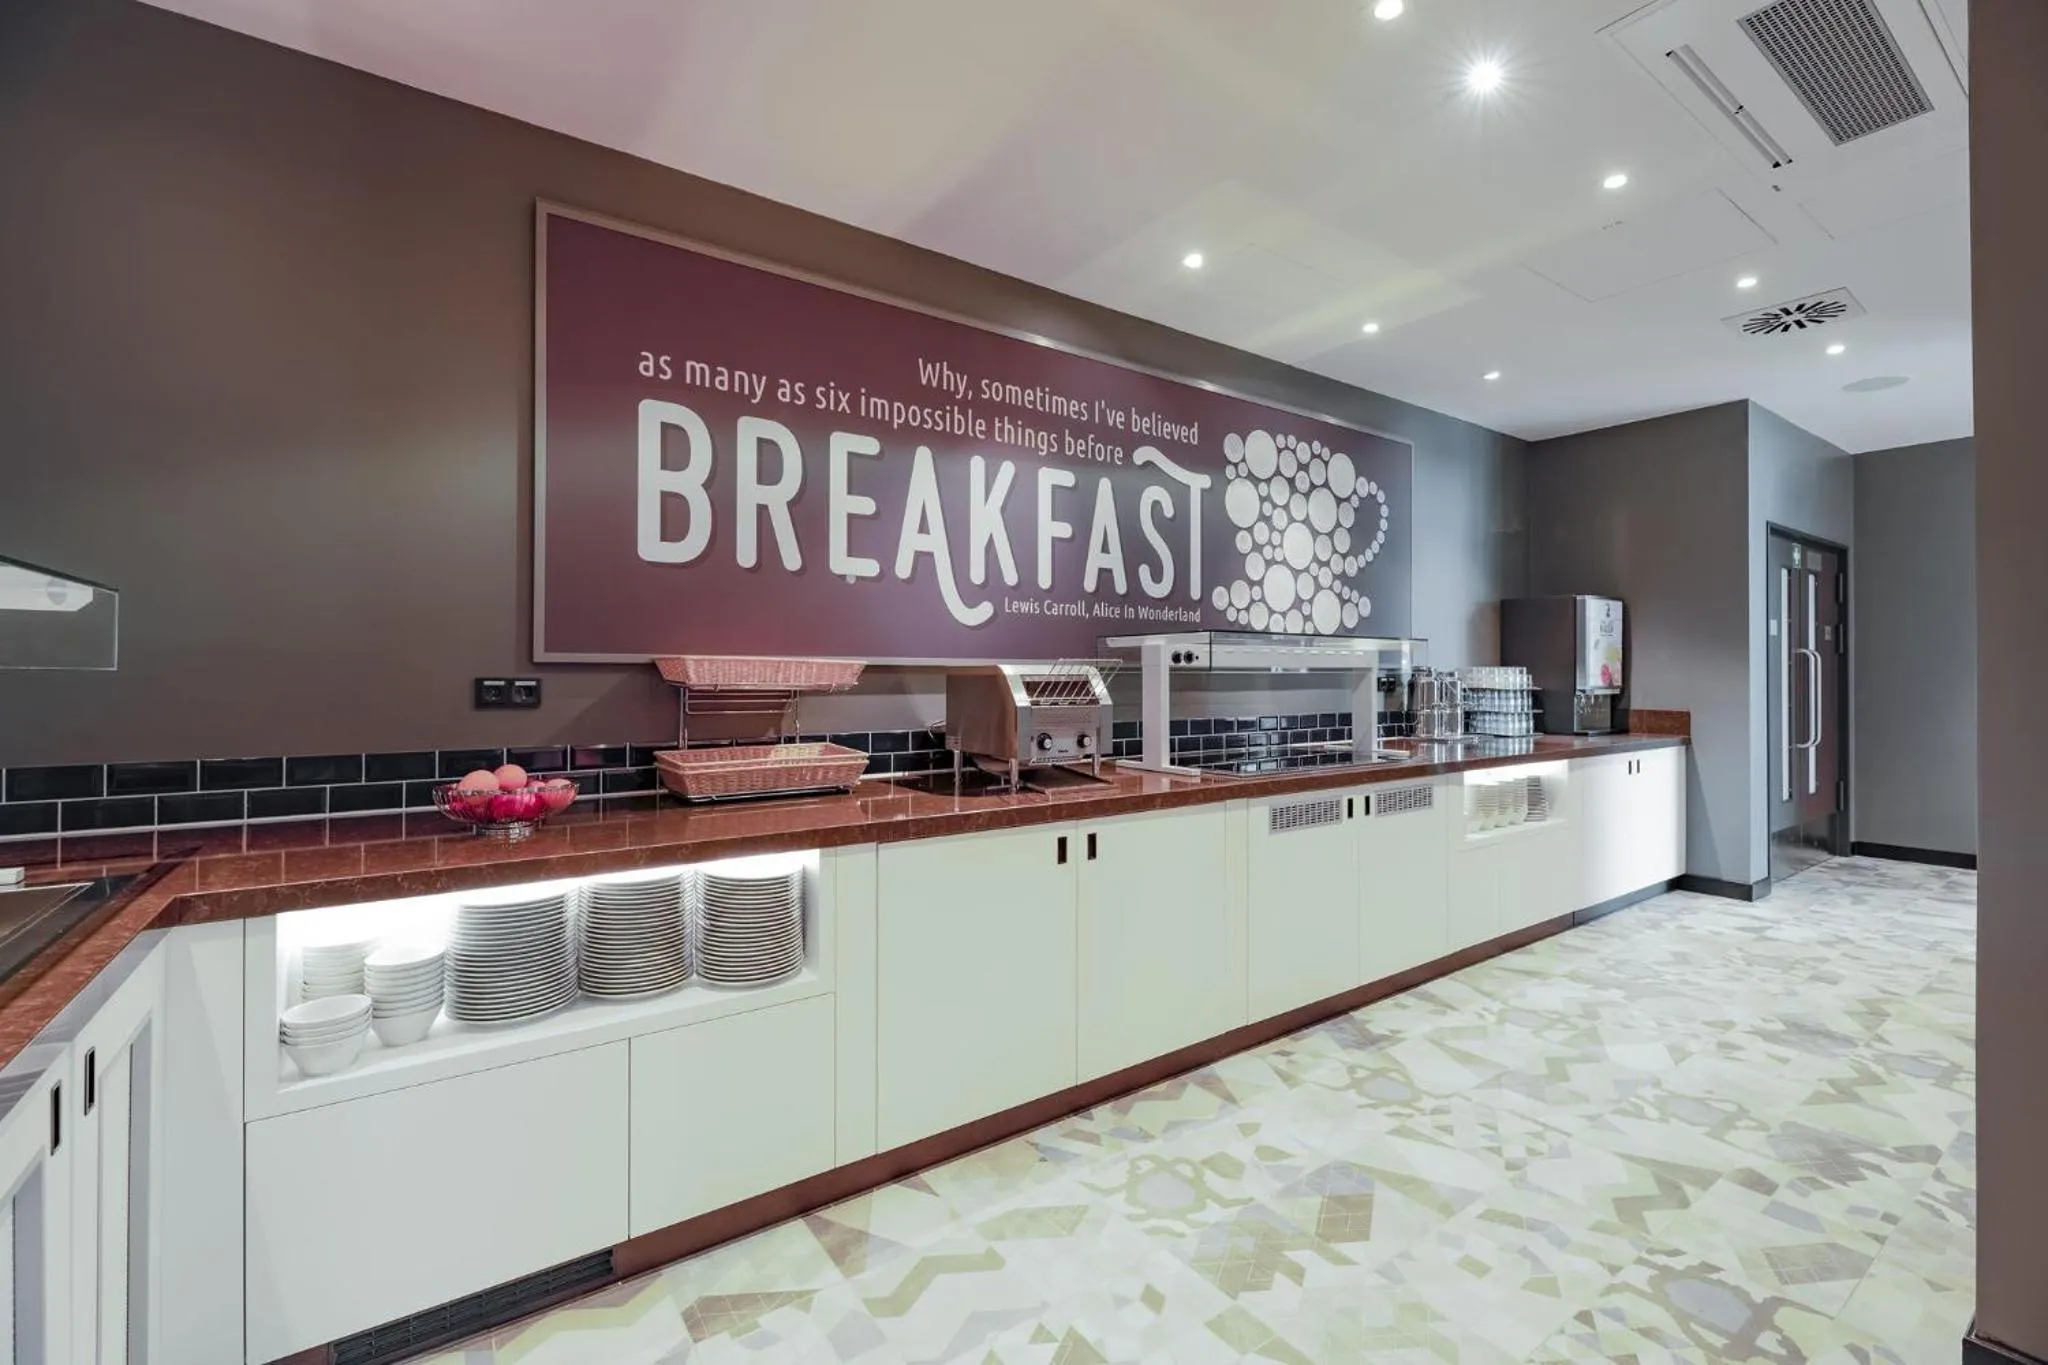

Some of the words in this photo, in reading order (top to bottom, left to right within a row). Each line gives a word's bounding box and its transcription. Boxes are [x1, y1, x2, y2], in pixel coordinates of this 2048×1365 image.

[638, 351, 672, 380] as
[685, 359, 767, 404] many
[777, 378, 806, 406] as
[815, 382, 851, 414] six
[860, 388, 987, 440] impossible
[994, 416, 1058, 456] things
[1065, 429, 1124, 465] before
[918, 357, 973, 400] Why,
[981, 377, 1088, 421] sometimes
[1095, 399, 1125, 430] I've
[1131, 407, 1199, 446] believed
[637, 398, 1212, 627] BREAKFAST
[1004, 596, 1040, 615] Lewis
[1043, 600, 1089, 620] Carroll,
[1093, 601, 1121, 619] Alice
[1124, 602, 1136, 619] In
[1137, 603, 1201, 623] Wonderland
